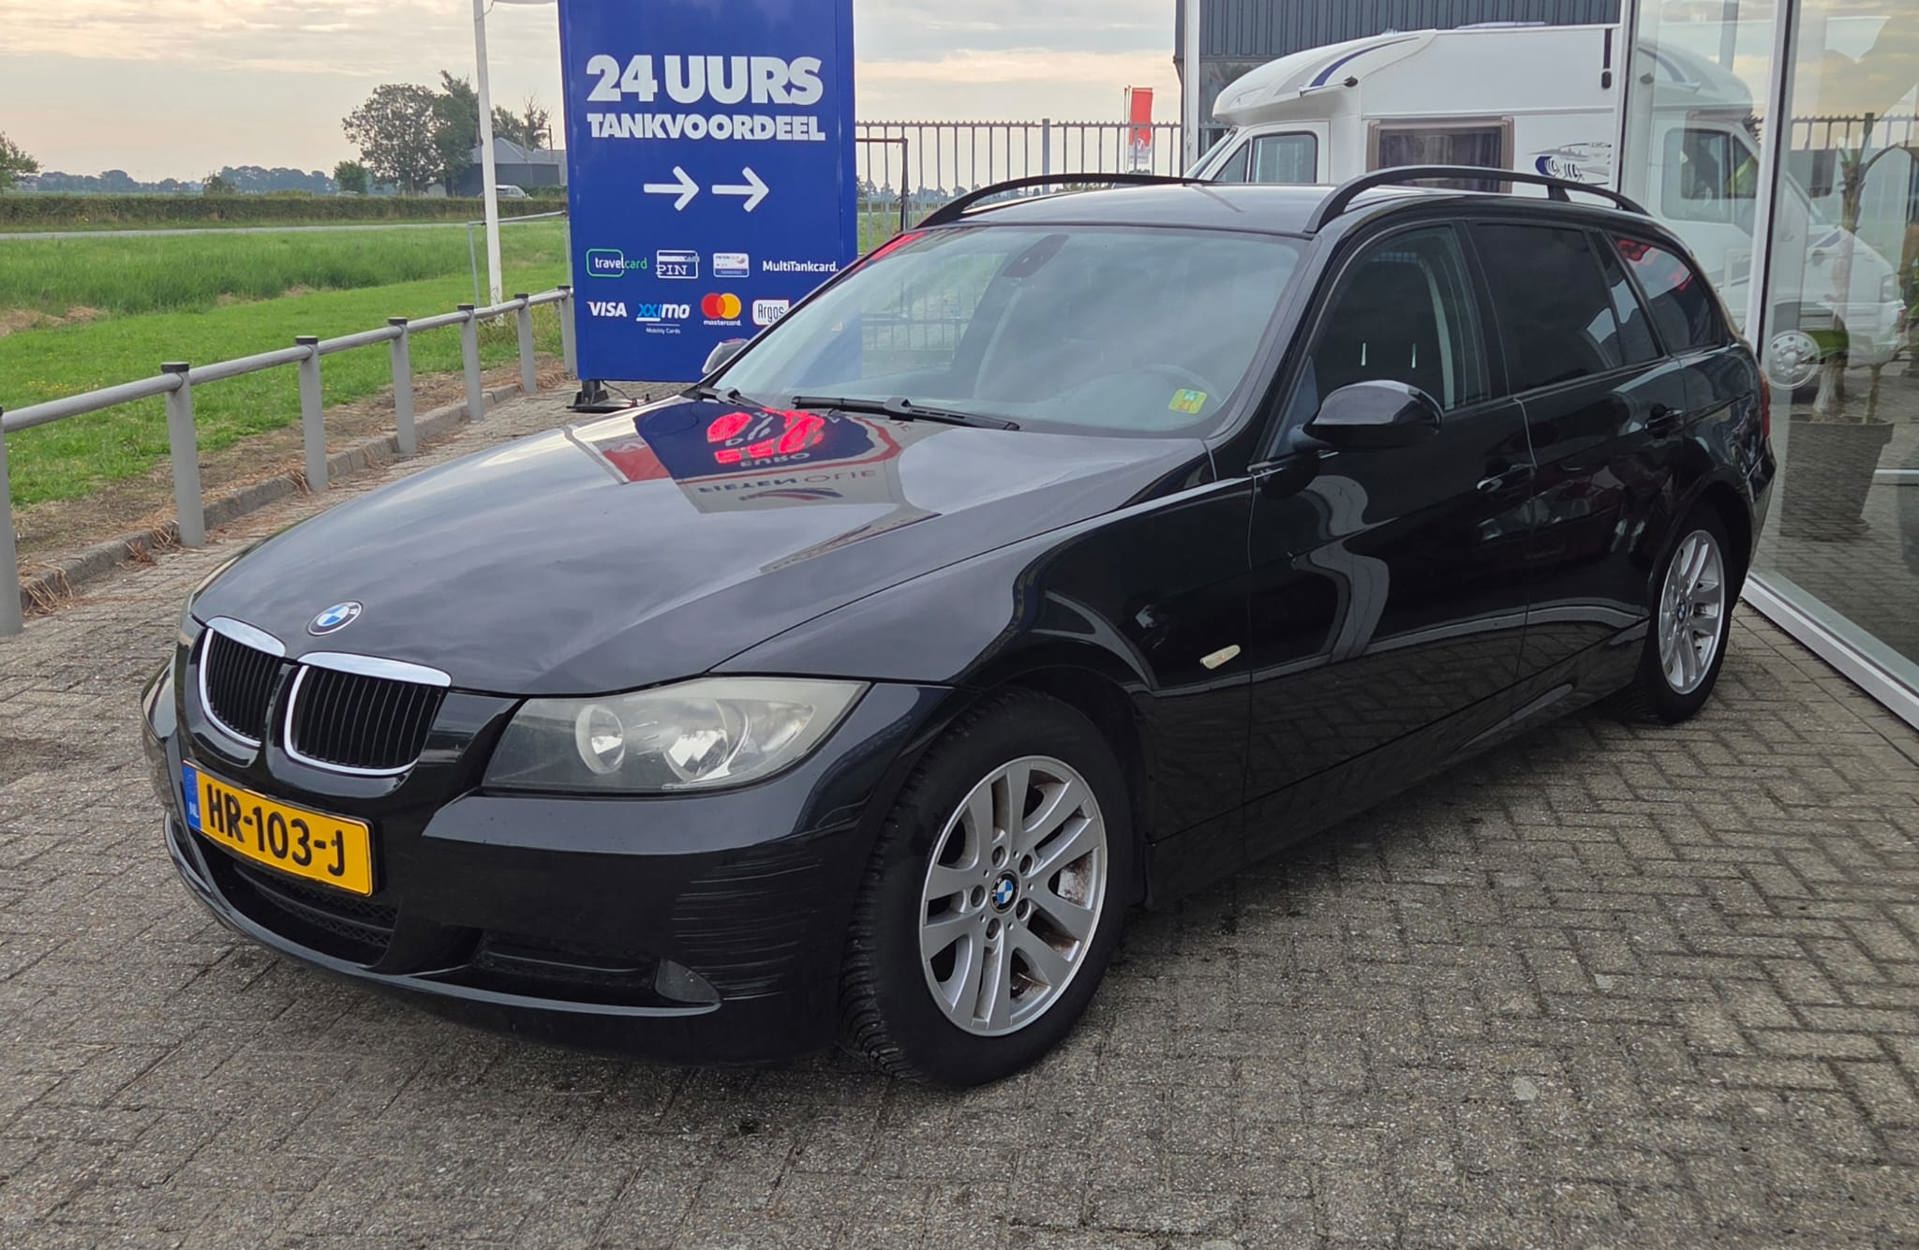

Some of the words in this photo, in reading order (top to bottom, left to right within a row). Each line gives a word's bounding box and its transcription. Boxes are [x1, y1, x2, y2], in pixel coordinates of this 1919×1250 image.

[586, 54, 658, 102] 24
[664, 55, 824, 106] UURS
[586, 113, 827, 141] TANKVOORDEEL
[594, 256, 648, 270] travelcard
[655, 264, 688, 276] PIN
[587, 301, 627, 318] VISA
[205, 783, 346, 877] HR-103-J
